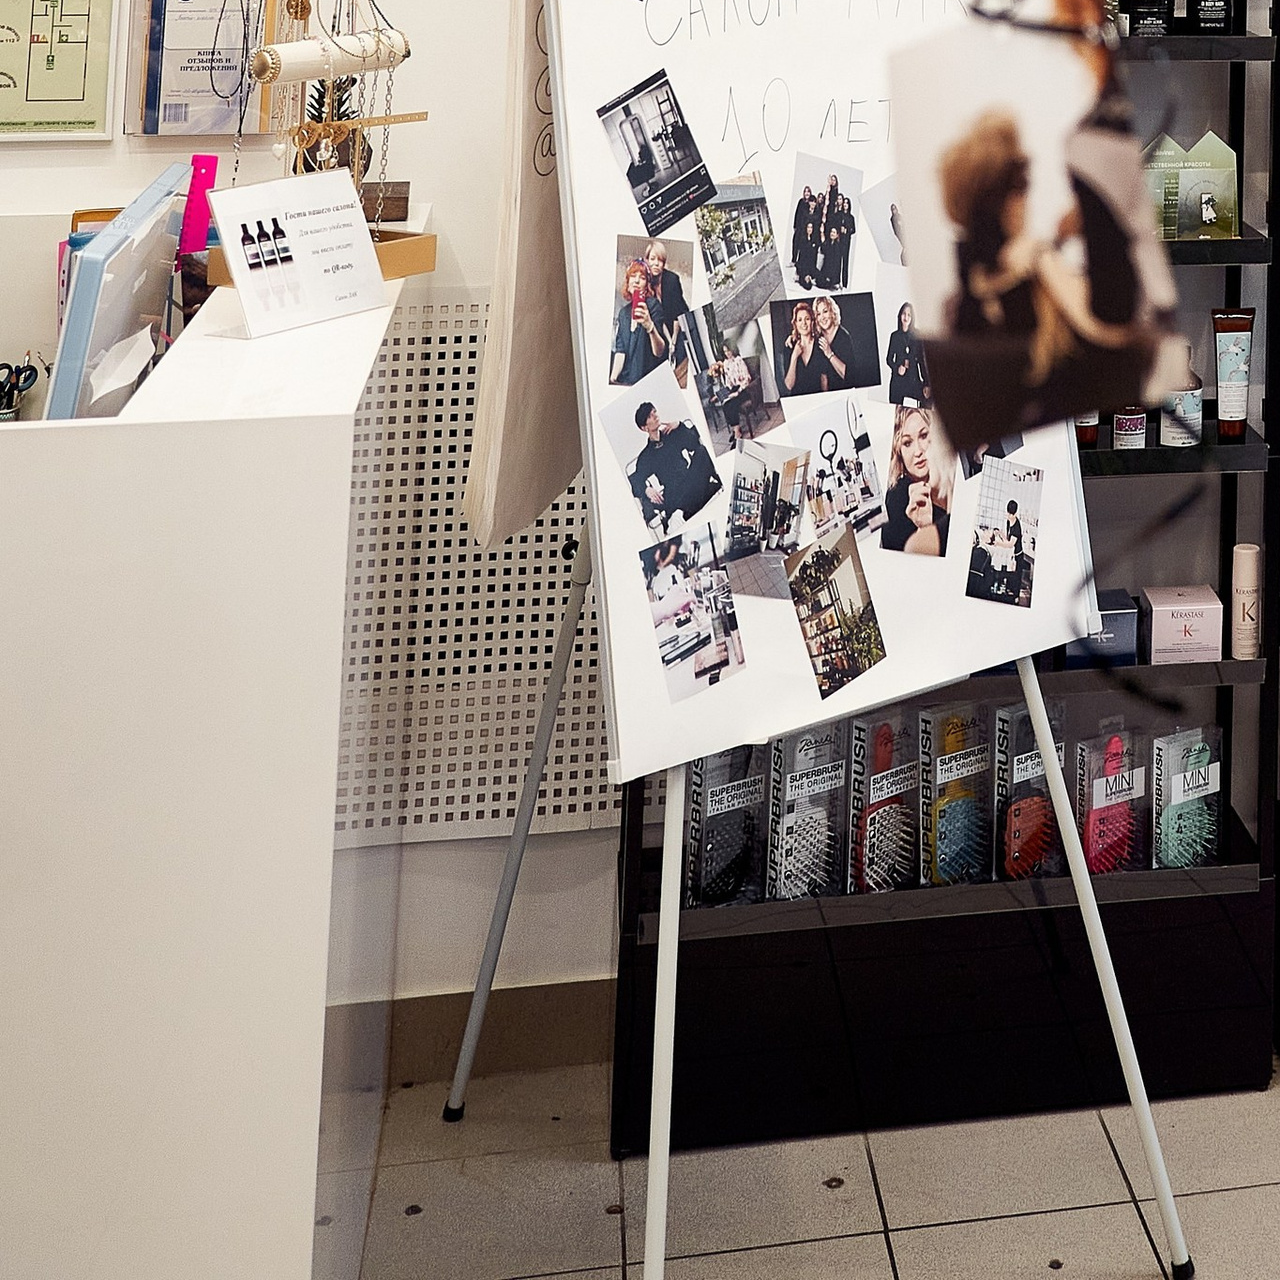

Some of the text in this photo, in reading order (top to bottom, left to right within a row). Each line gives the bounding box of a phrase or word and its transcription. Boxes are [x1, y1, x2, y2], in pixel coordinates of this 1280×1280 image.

[721, 77, 792, 173] 10
[1171, 610, 1204, 620] KÉRASTASE
[1242, 601, 1256, 623] K
[939, 745, 989, 767] SUPERBRUSH
[939, 756, 988, 775] THE ORIGINAL
[789, 761, 843, 784] SUPERBRUSH
[871, 763, 918, 787] SUPERBRUSH
[1016, 765, 1029, 775] THE
[1183, 766, 1209, 790] MINI
[709, 777, 763, 799] SUPERBRUSH
[790, 773, 842, 792] THE ORIGINAL
[871, 773, 917, 795] THE ORIGINAL
[1105, 770, 1134, 793] MINI
[709, 787, 763, 807] THE ORIGINAL
[921, 718, 932, 882] SUPERBRUSH
[768, 739, 784, 897] SUPERBRUSH
